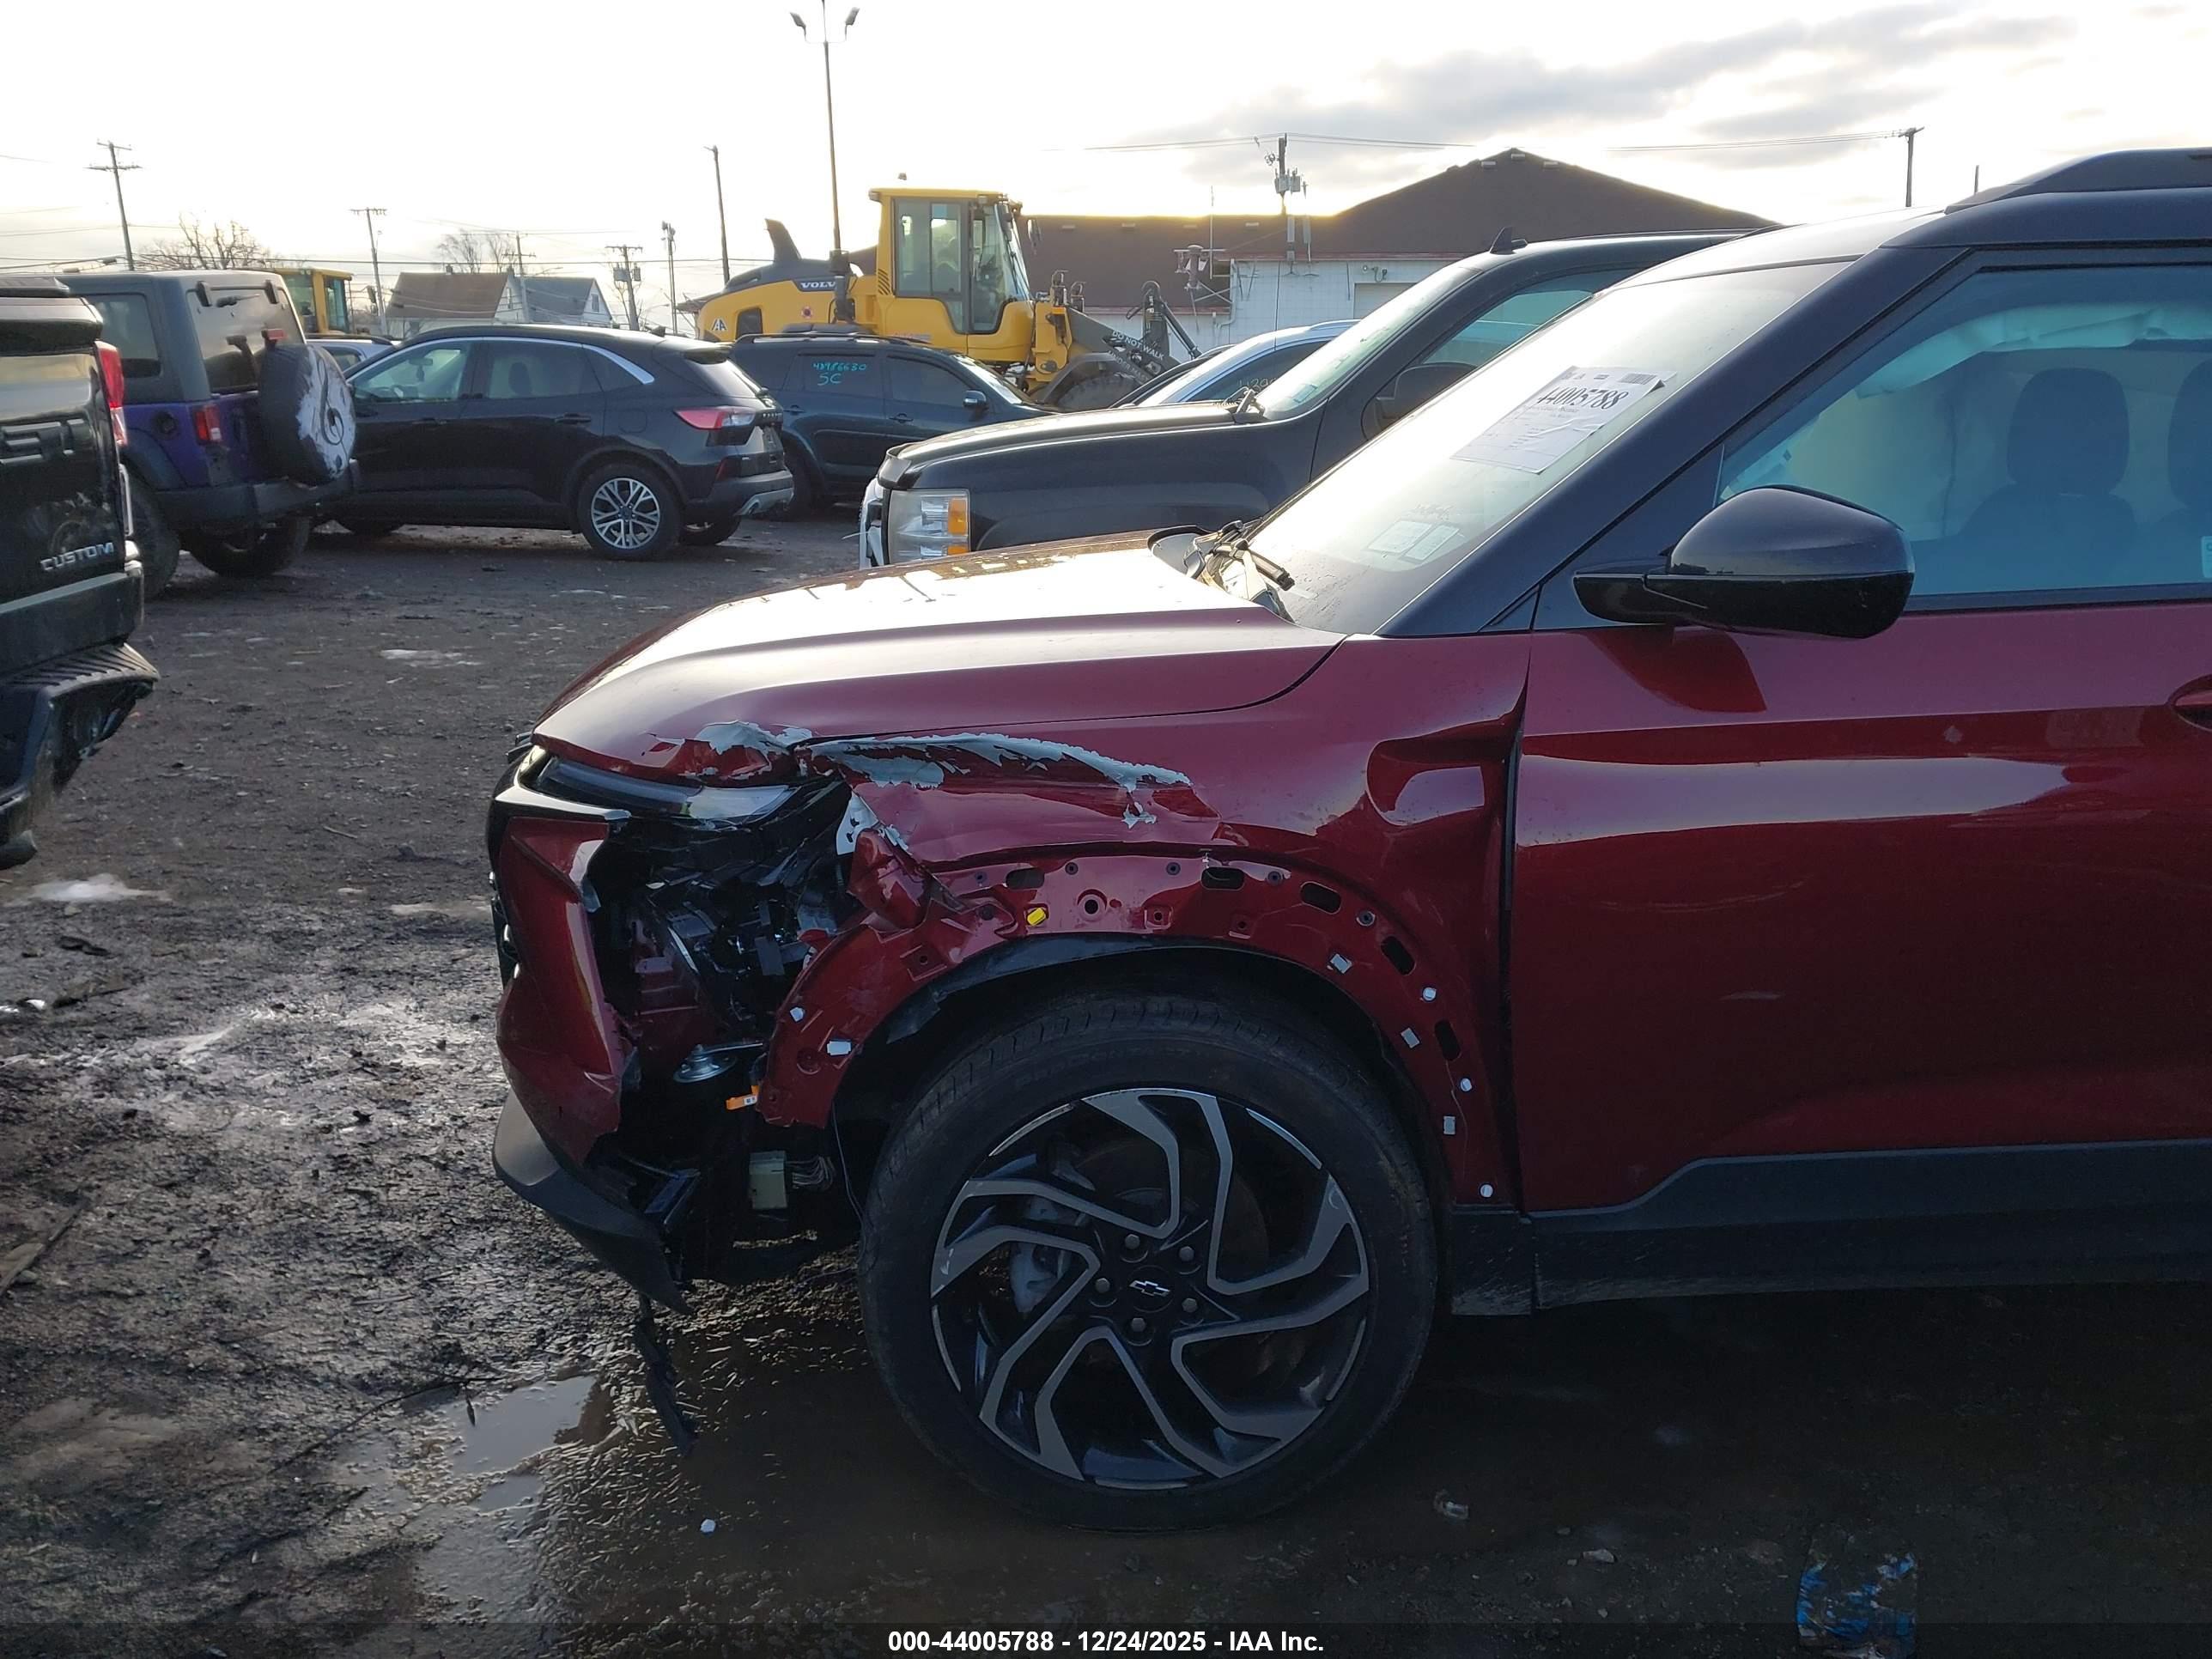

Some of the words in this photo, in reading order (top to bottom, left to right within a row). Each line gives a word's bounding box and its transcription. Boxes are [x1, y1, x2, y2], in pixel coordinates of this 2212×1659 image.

[800, 281, 836, 289] VOLV
[1112, 331, 1125, 340] DO
[1125, 337, 1143, 349] NOT
[1143, 344, 1164, 360] WALK
[40, 542, 114, 571] CUSTOM
